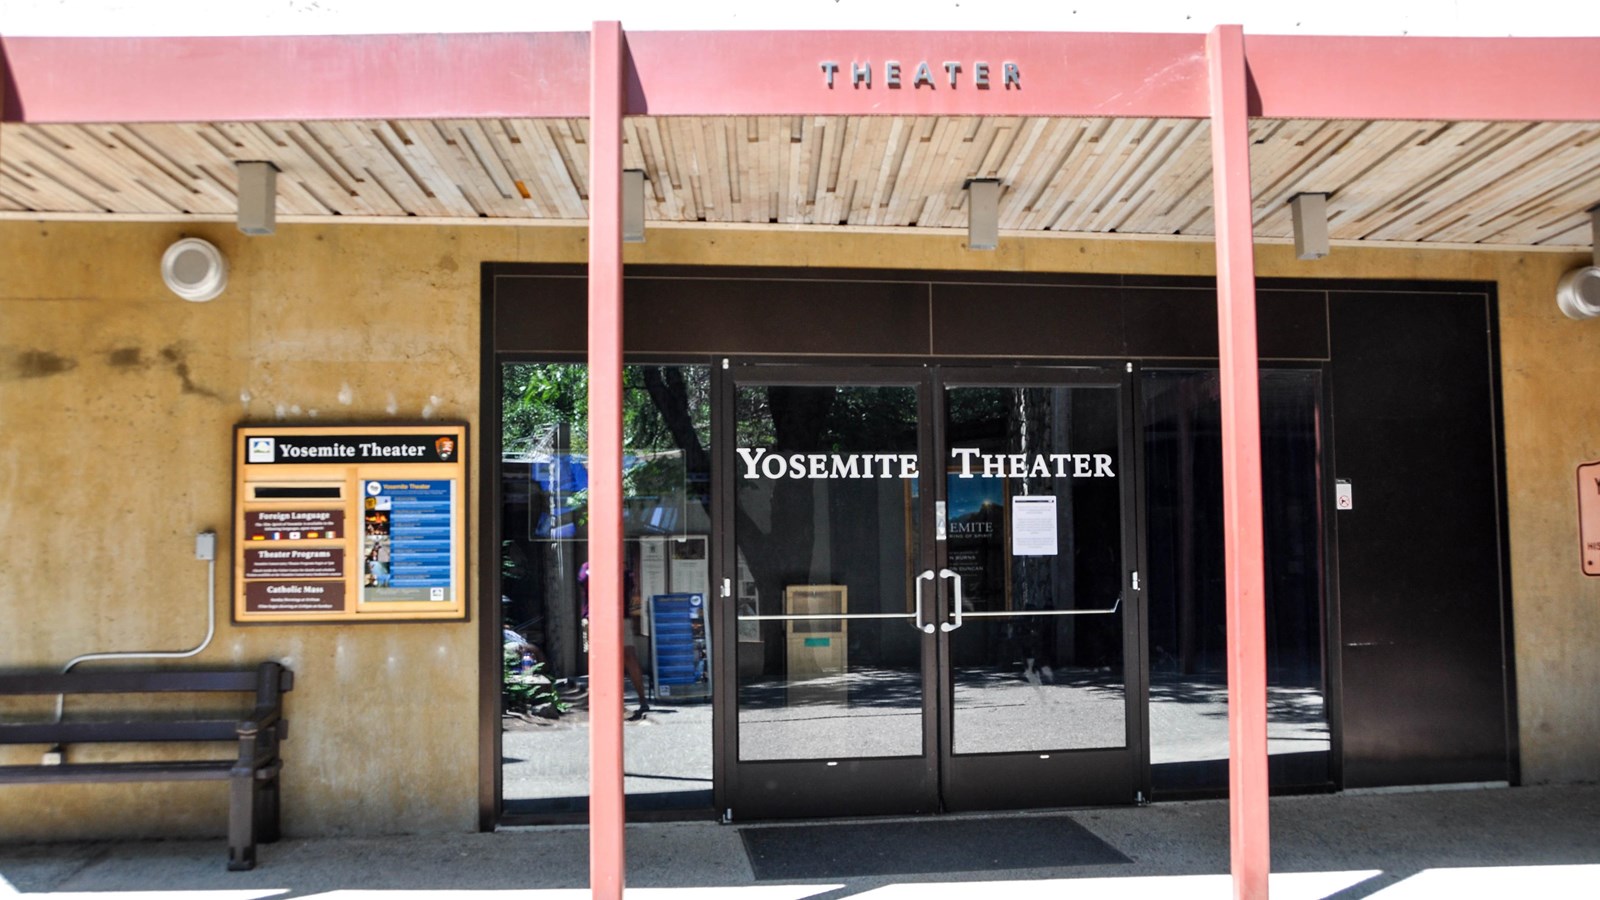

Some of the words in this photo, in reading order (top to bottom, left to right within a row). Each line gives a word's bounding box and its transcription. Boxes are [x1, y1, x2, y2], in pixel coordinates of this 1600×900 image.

[819, 60, 1021, 90] THEATER
[279, 443, 356, 458] Yosemite
[359, 442, 426, 457] Theater
[736, 447, 920, 479] YOSEMITE
[951, 447, 1115, 478] THEATER
[258, 512, 290, 521] Foreign
[291, 511, 330, 521] Language
[949, 522, 994, 533] EMITE
[258, 550, 290, 558] Theater
[291, 550, 331, 559] Programs
[266, 585, 302, 593] Catholic
[303, 585, 324, 593] Mass
